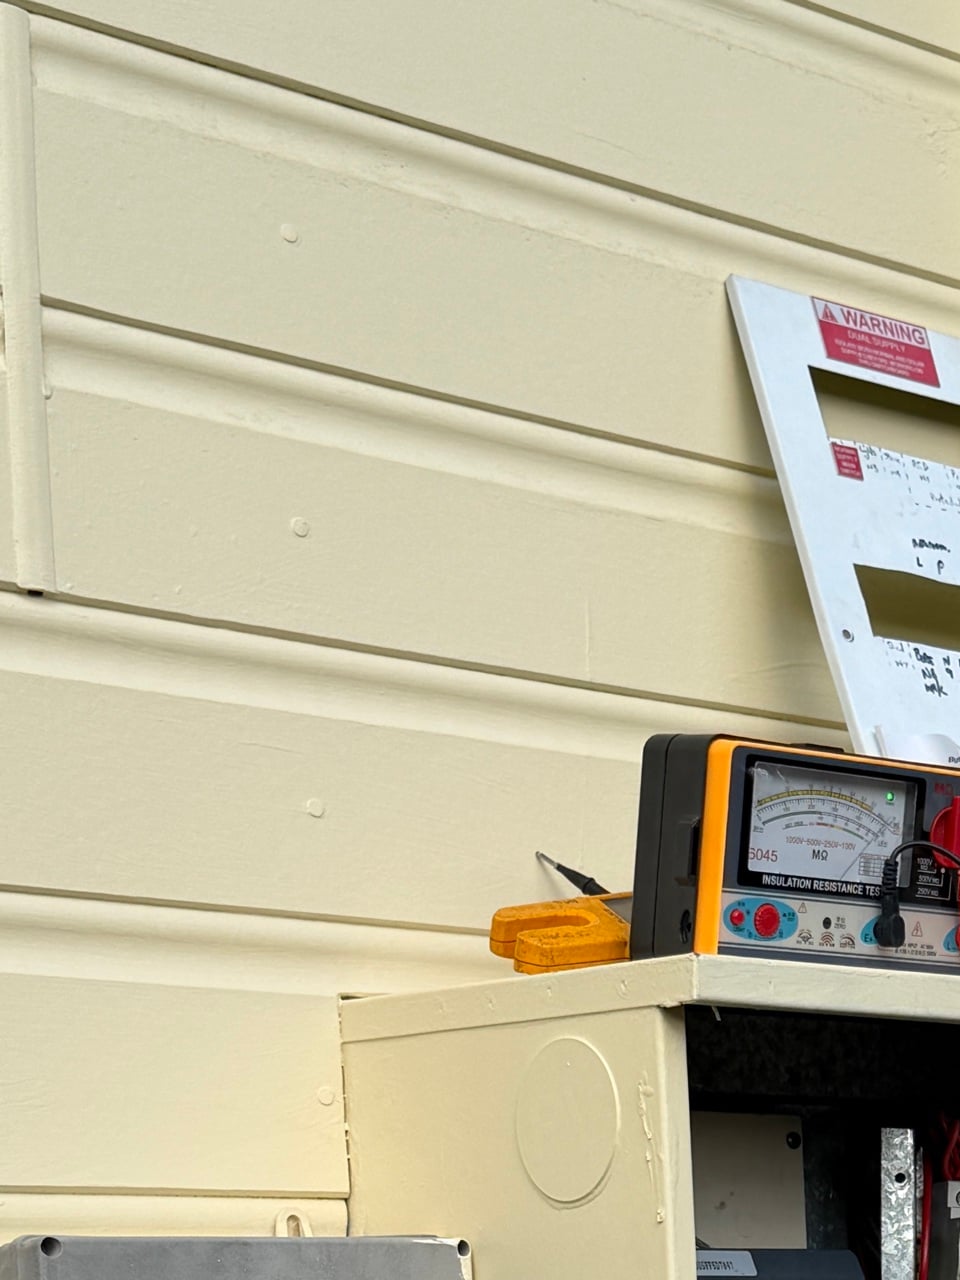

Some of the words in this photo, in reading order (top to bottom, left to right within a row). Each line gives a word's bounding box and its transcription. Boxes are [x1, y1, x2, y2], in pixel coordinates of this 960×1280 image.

[841, 307, 925, 345] WARNING
[762, 874, 812, 890] INSULATION
[813, 879, 863, 895] RESISTANCE
[865, 886, 881, 897] TES
